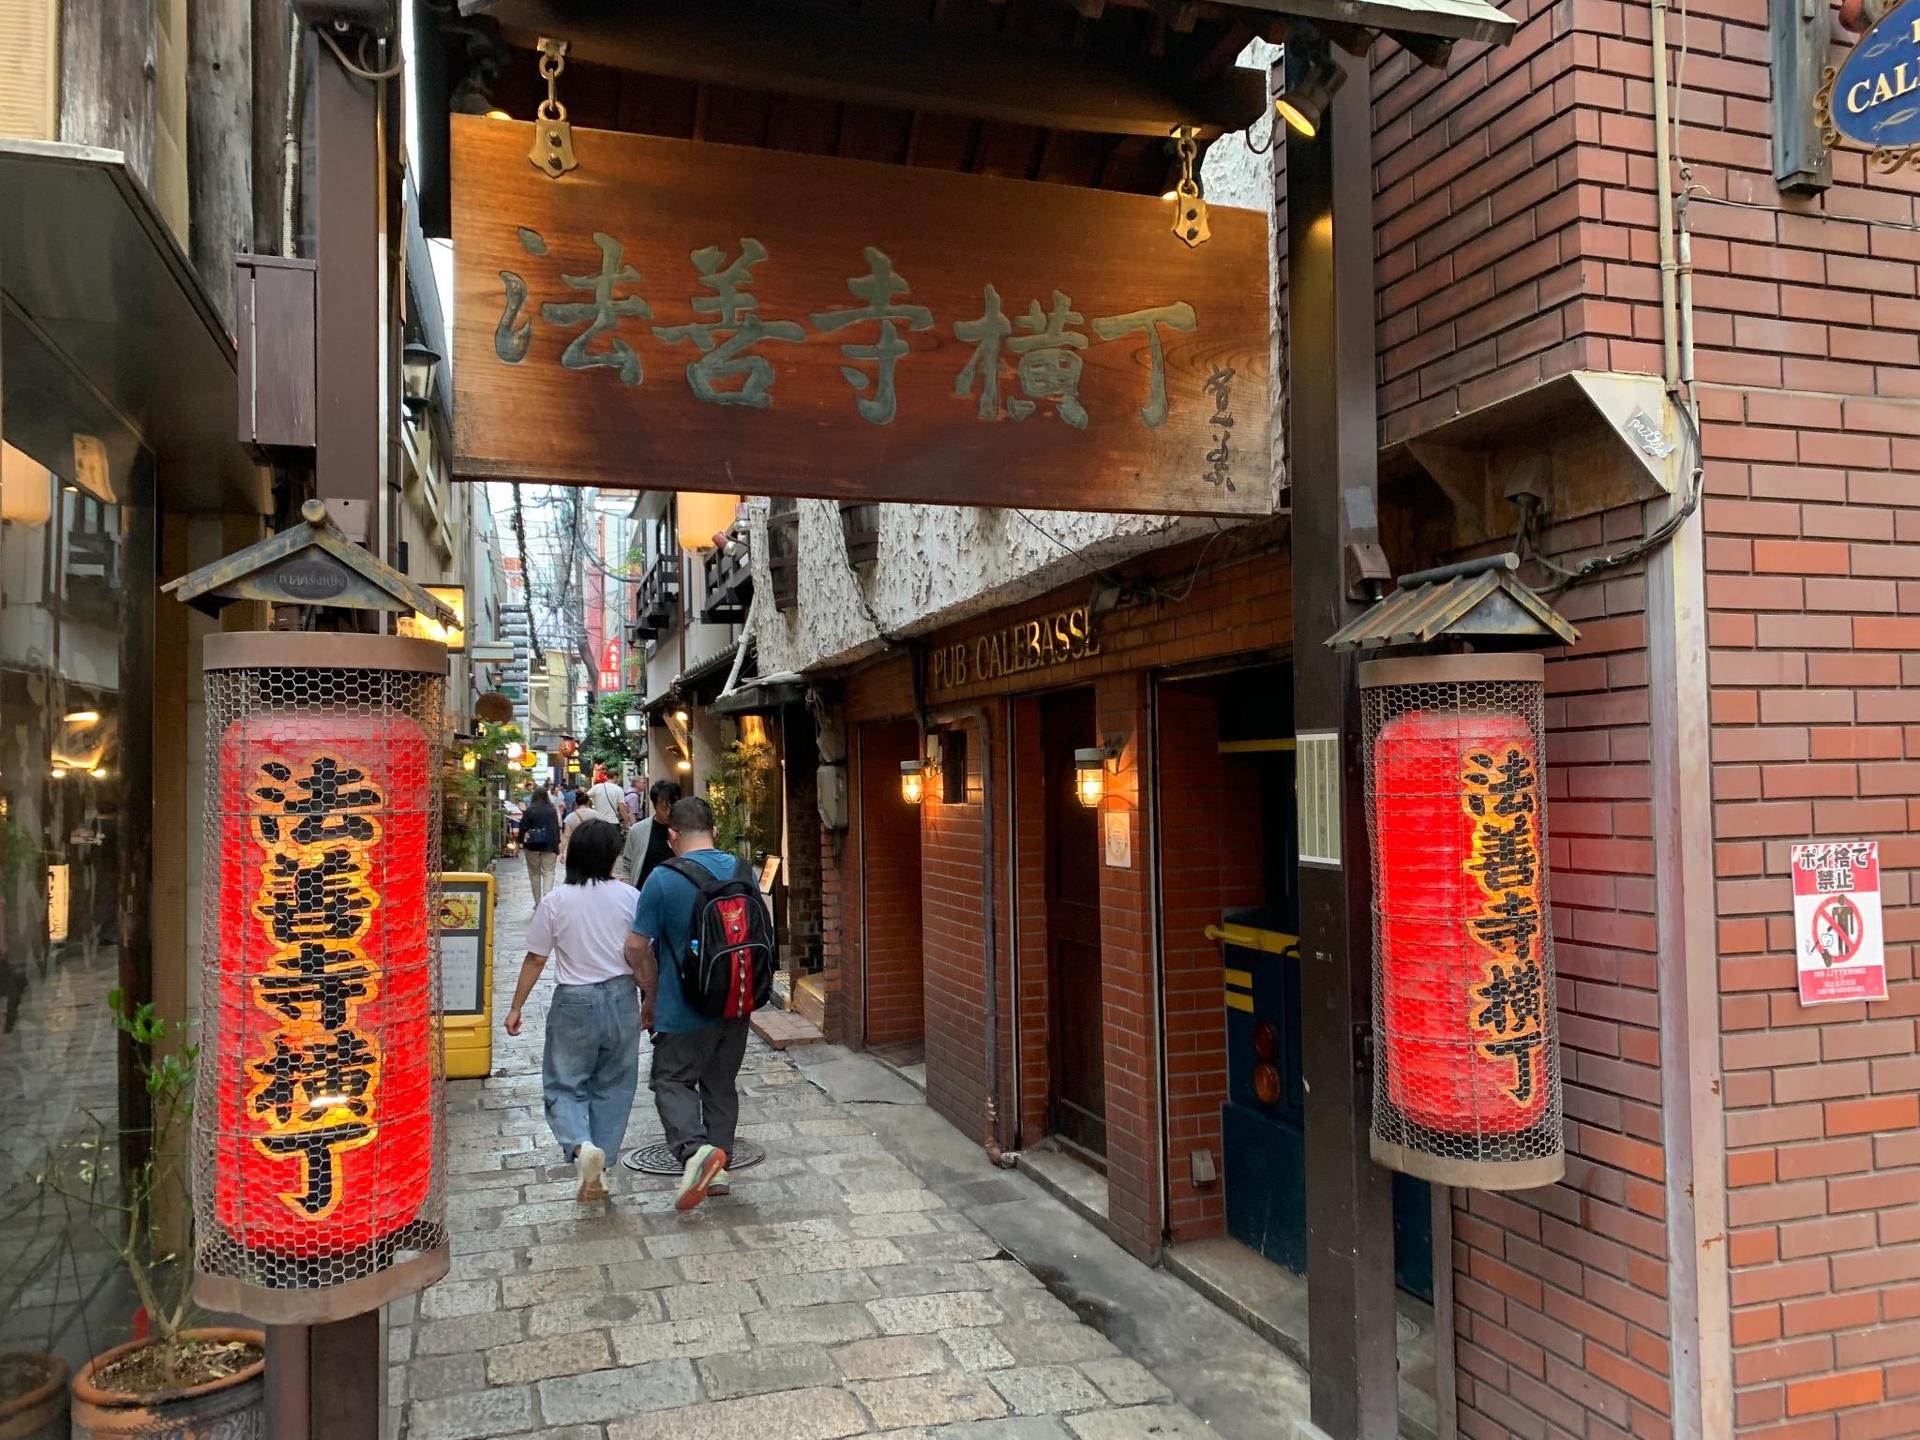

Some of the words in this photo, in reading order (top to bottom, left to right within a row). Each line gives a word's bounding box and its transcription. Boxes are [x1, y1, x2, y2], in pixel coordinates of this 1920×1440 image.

[1847, 57, 1920, 113] CAL
[495, 226, 1198, 429] 法善寺横丁
[933, 643, 967, 689] PUB
[1801, 847, 1868, 869] ポイ捨て
[1817, 869, 1853, 890] 禁止
[1466, 747, 1540, 1103] 法善寺横丁
[253, 754, 383, 1219] 法善寺横丁
